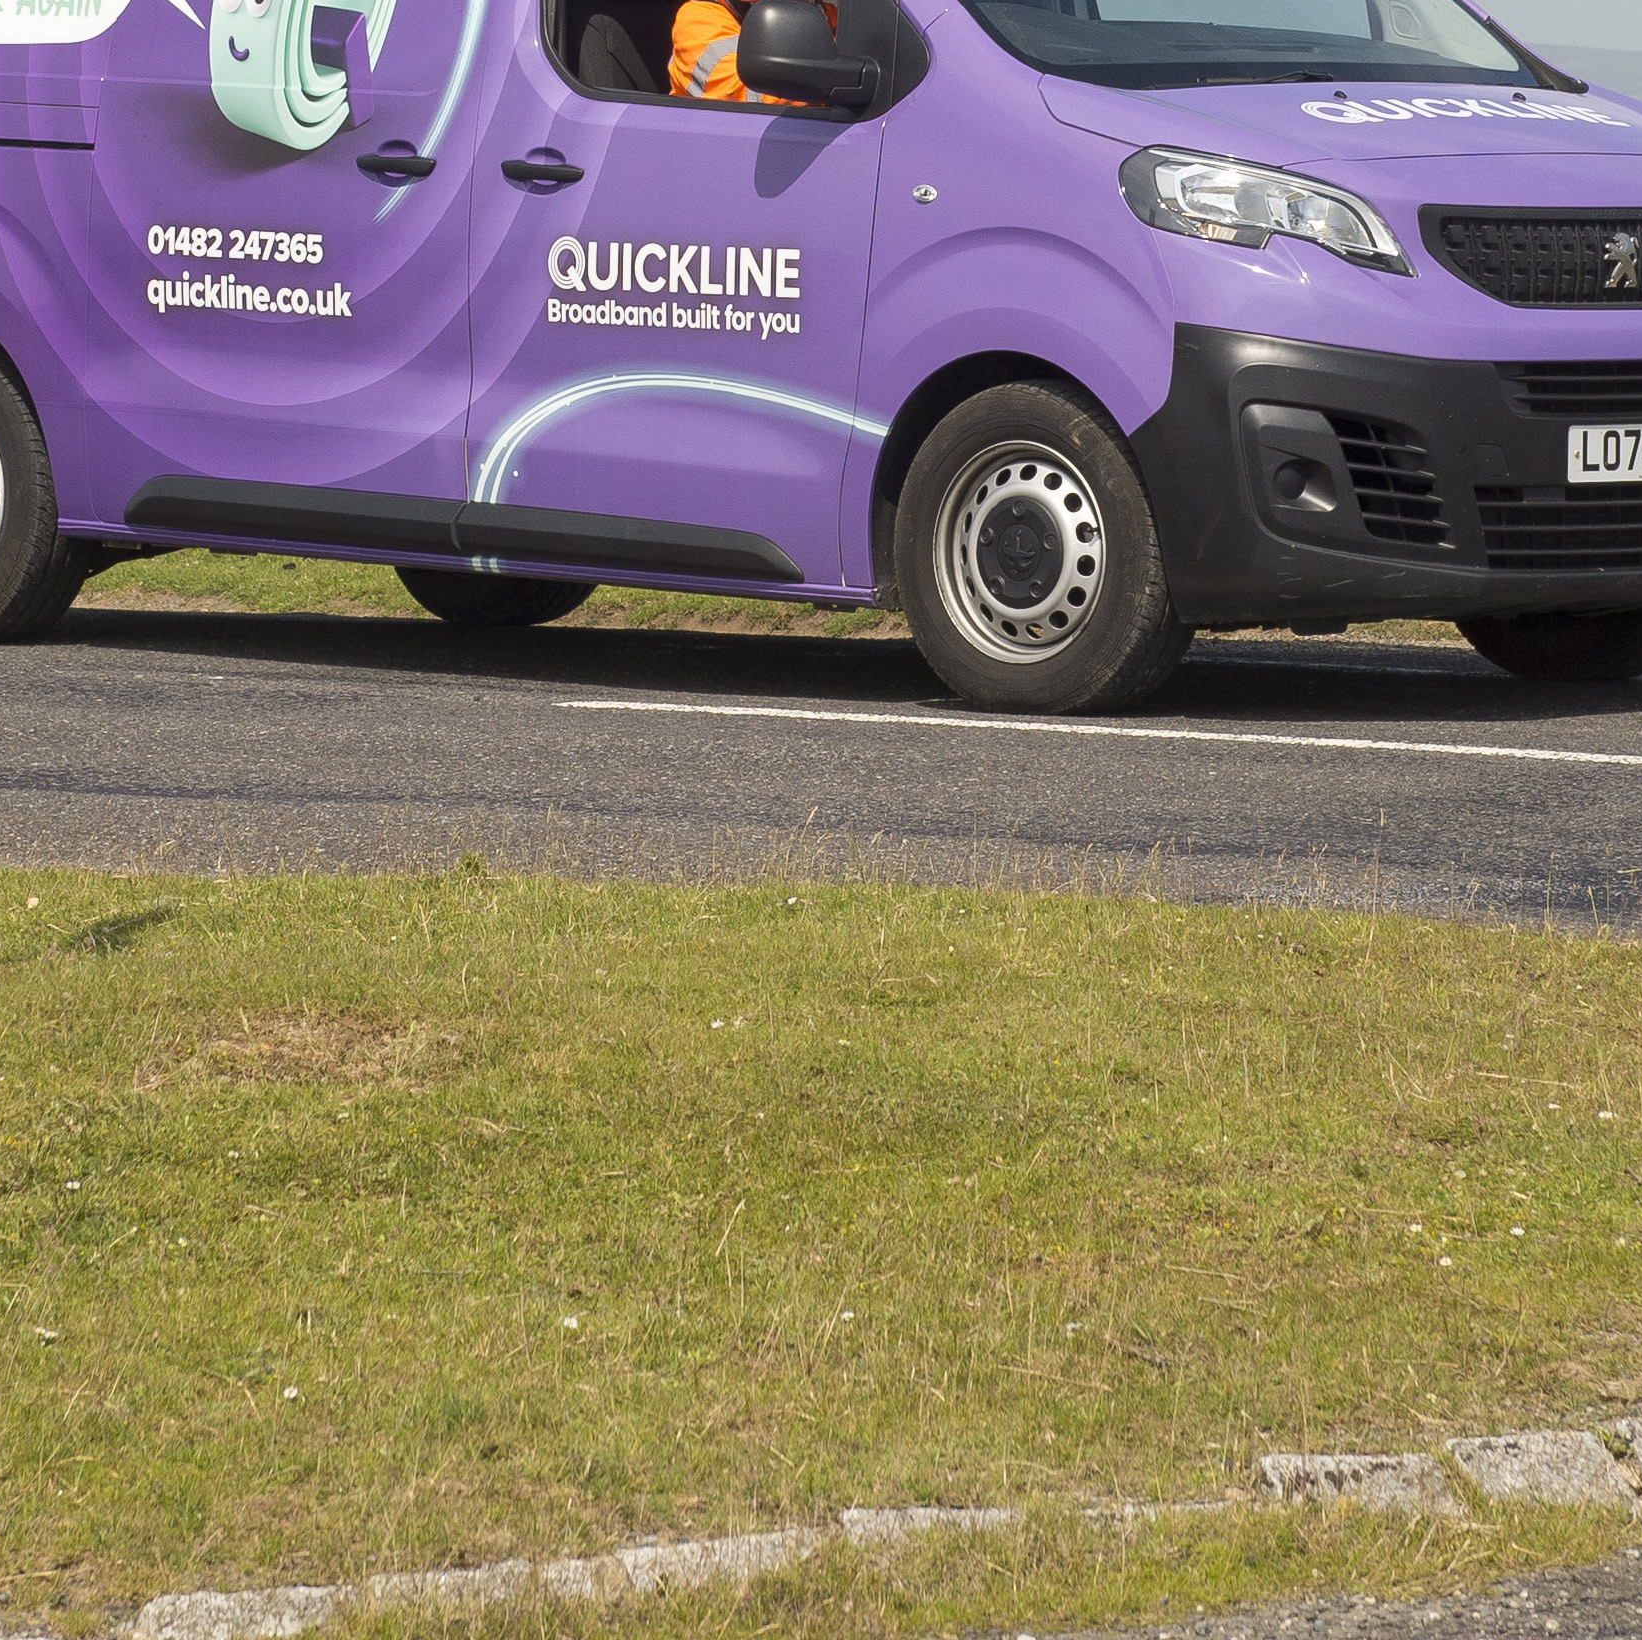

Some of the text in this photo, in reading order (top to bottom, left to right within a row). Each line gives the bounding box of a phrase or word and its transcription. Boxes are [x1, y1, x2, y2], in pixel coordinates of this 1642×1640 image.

[1300, 96, 1631, 128] QUICKLINE
[147, 224, 324, 264] 01482 247365
[547, 235, 801, 299] QUICKLINE
[147, 270, 353, 317] quickline.co.uk
[547, 298, 801, 341] Broadband built for you
